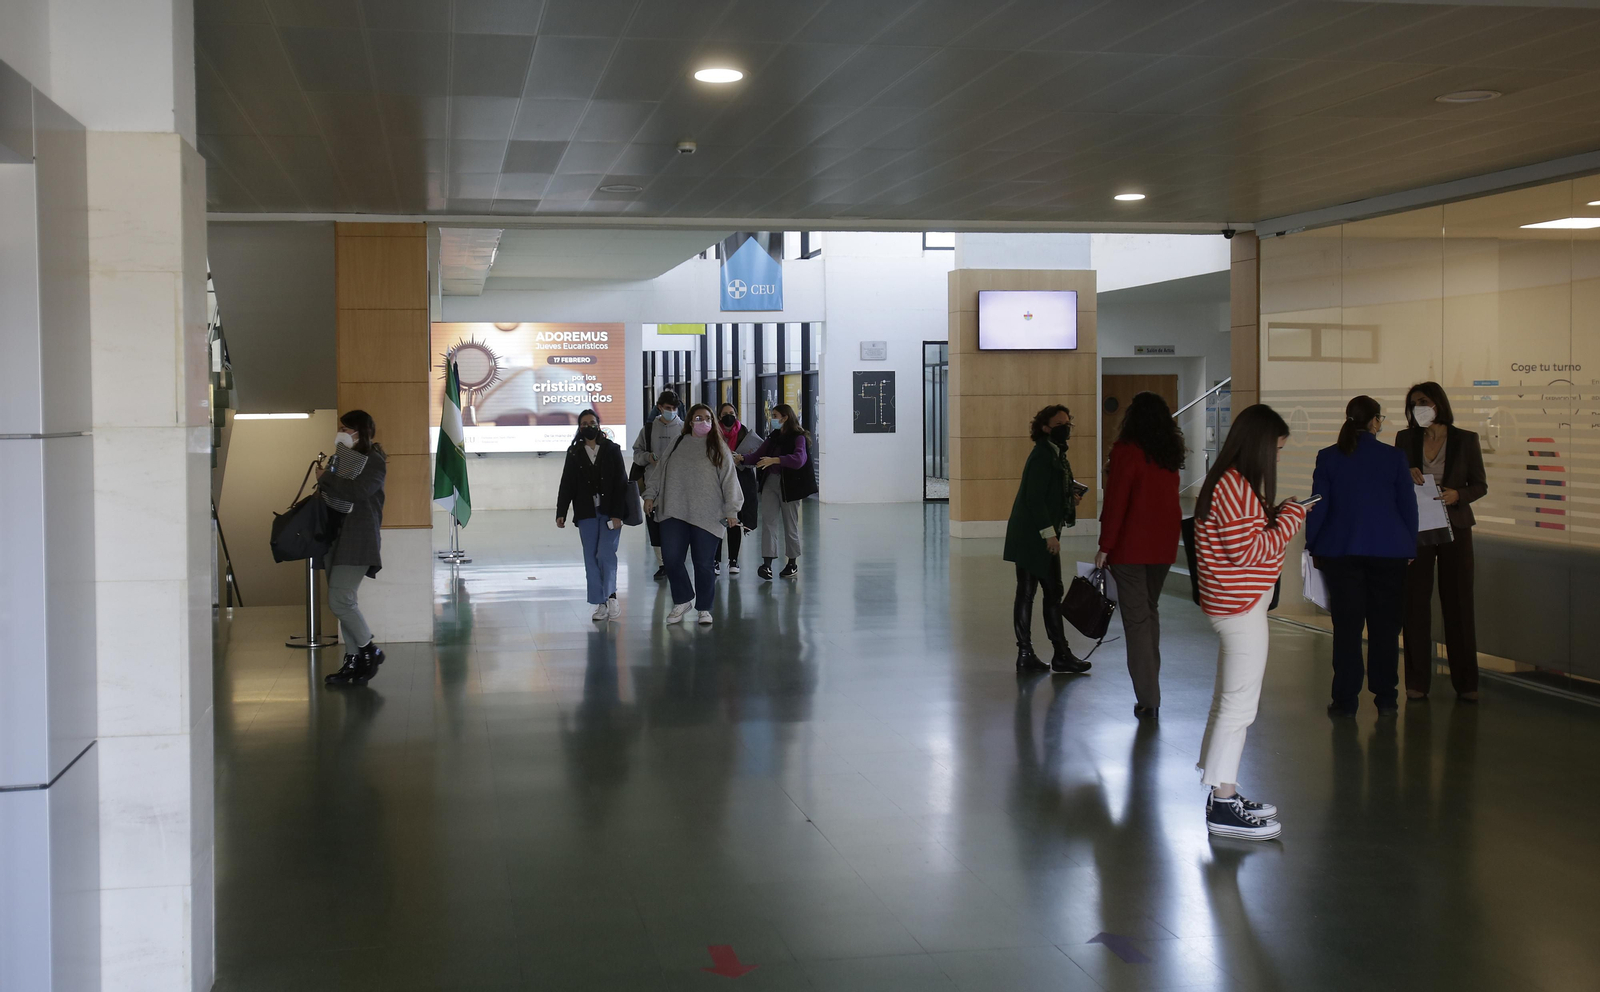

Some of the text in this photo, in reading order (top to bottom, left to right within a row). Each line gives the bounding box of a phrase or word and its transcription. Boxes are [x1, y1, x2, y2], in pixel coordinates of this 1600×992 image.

[750, 284, 775, 295] CEU
[535, 331, 608, 342] ADOREMUS
[535, 342, 609, 350] Jueves Eucarísticos
[1511, 362, 1582, 374] Coge tu turno
[532, 380, 602, 392] cristianos
[542, 393, 612, 405] perseguidos
